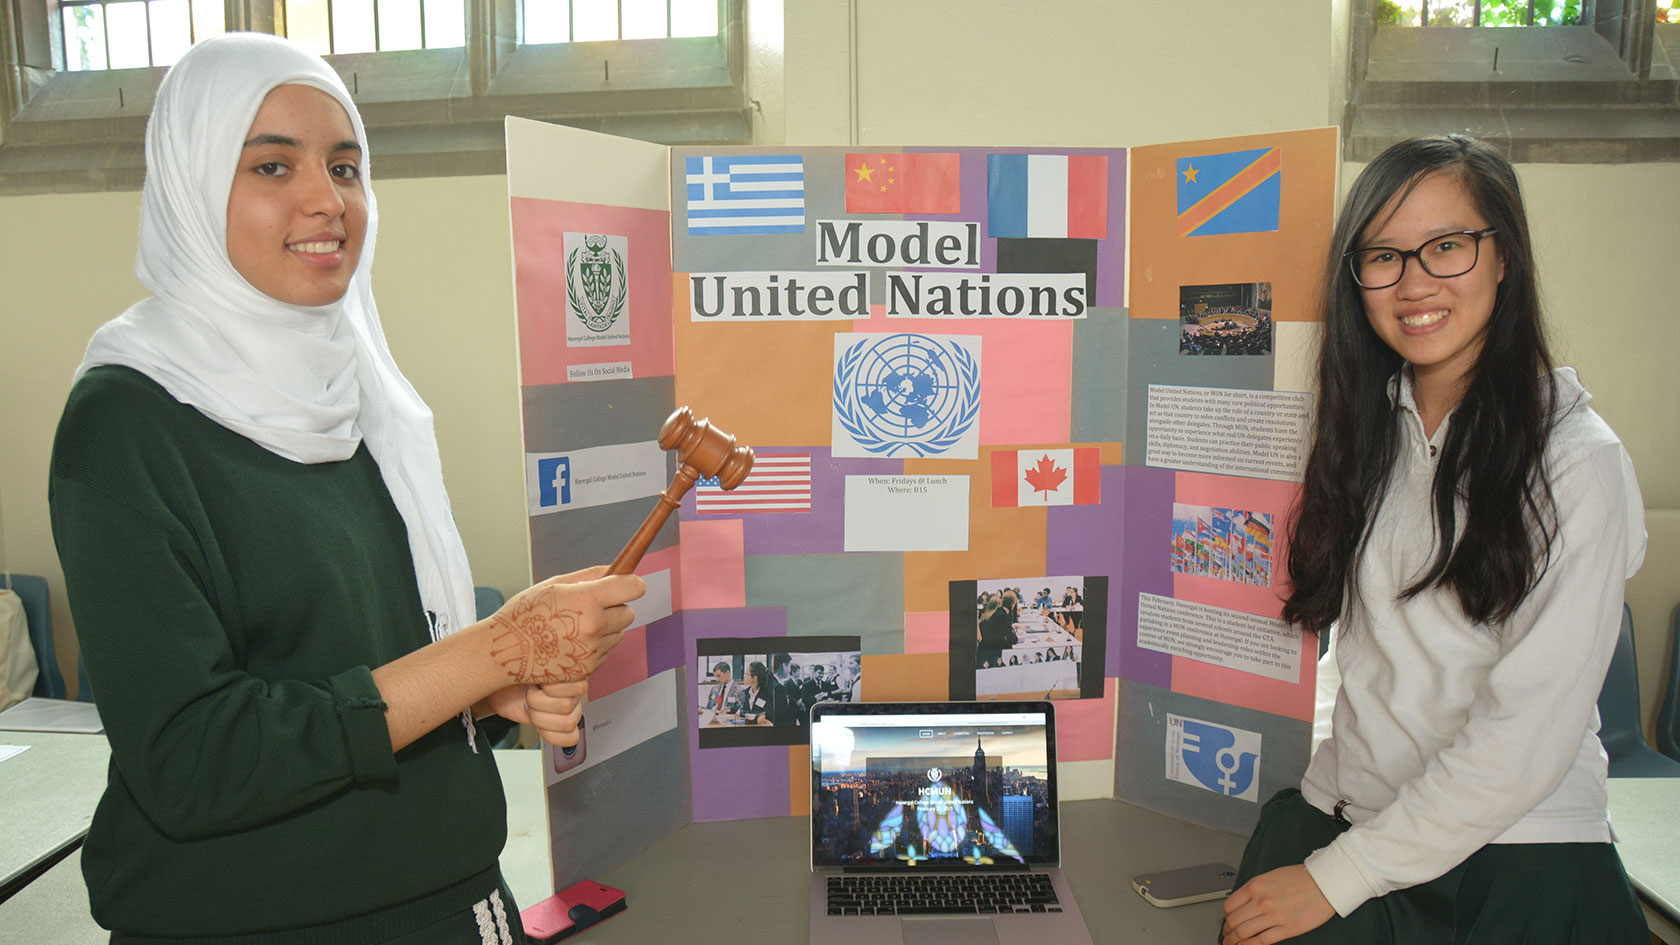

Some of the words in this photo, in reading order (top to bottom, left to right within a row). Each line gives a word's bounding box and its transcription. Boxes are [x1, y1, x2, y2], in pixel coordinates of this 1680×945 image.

[817, 222, 979, 265] Model
[690, 273, 870, 317] United
[888, 274, 1085, 316] Nations
[602, 366, 616, 375] Social
[1259, 393, 1290, 401] competitive
[1149, 425, 1176, 433] opportunity
[1184, 428, 1210, 436] experience
[1246, 433, 1271, 441] delegates
[1272, 435, 1302, 444] experience
[1162, 442, 1187, 450] diplomacy,
[1200, 445, 1227, 454] negotiation
[1272, 443, 1297, 452] speaking
[1182, 459, 1217, 469] understanding
[1235, 464, 1268, 472] international
[574, 476, 592, 485] Havergal
[592, 475, 606, 483] College
[892, 478, 916, 486] Fridays
[1152, 597, 1175, 607] February,
[1176, 602, 1197, 612] Havergal
[1204, 608, 1221, 617] hosting
[1140, 609, 1159, 618] involves
[1160, 614, 1181, 622] students
[1214, 625, 1232, 633] schools
[1233, 629, 1251, 637] around
[1176, 609, 1203, 619] conference.
[1256, 626, 1281, 636] initiative,
[1140, 616, 1162, 626] partaking
[1186, 626, 1212, 636] conference
[1220, 633, 1242, 644] Havergal.
[1270, 644, 1289, 654] looking
[1140, 623, 1165, 634] experience
[1180, 632, 1201, 642] planning
[1212, 639, 1238, 650] leadership
[1139, 638, 1168, 650] academically
[1170, 645, 1192, 655] enriching
[1193, 650, 1223, 662] opportunity.
[1185, 641, 1204, 651] strongly
[1206, 647, 1231, 657] encourage
[1169, 717, 1182, 727] UN
[918, 788, 952, 796] HCMUN
